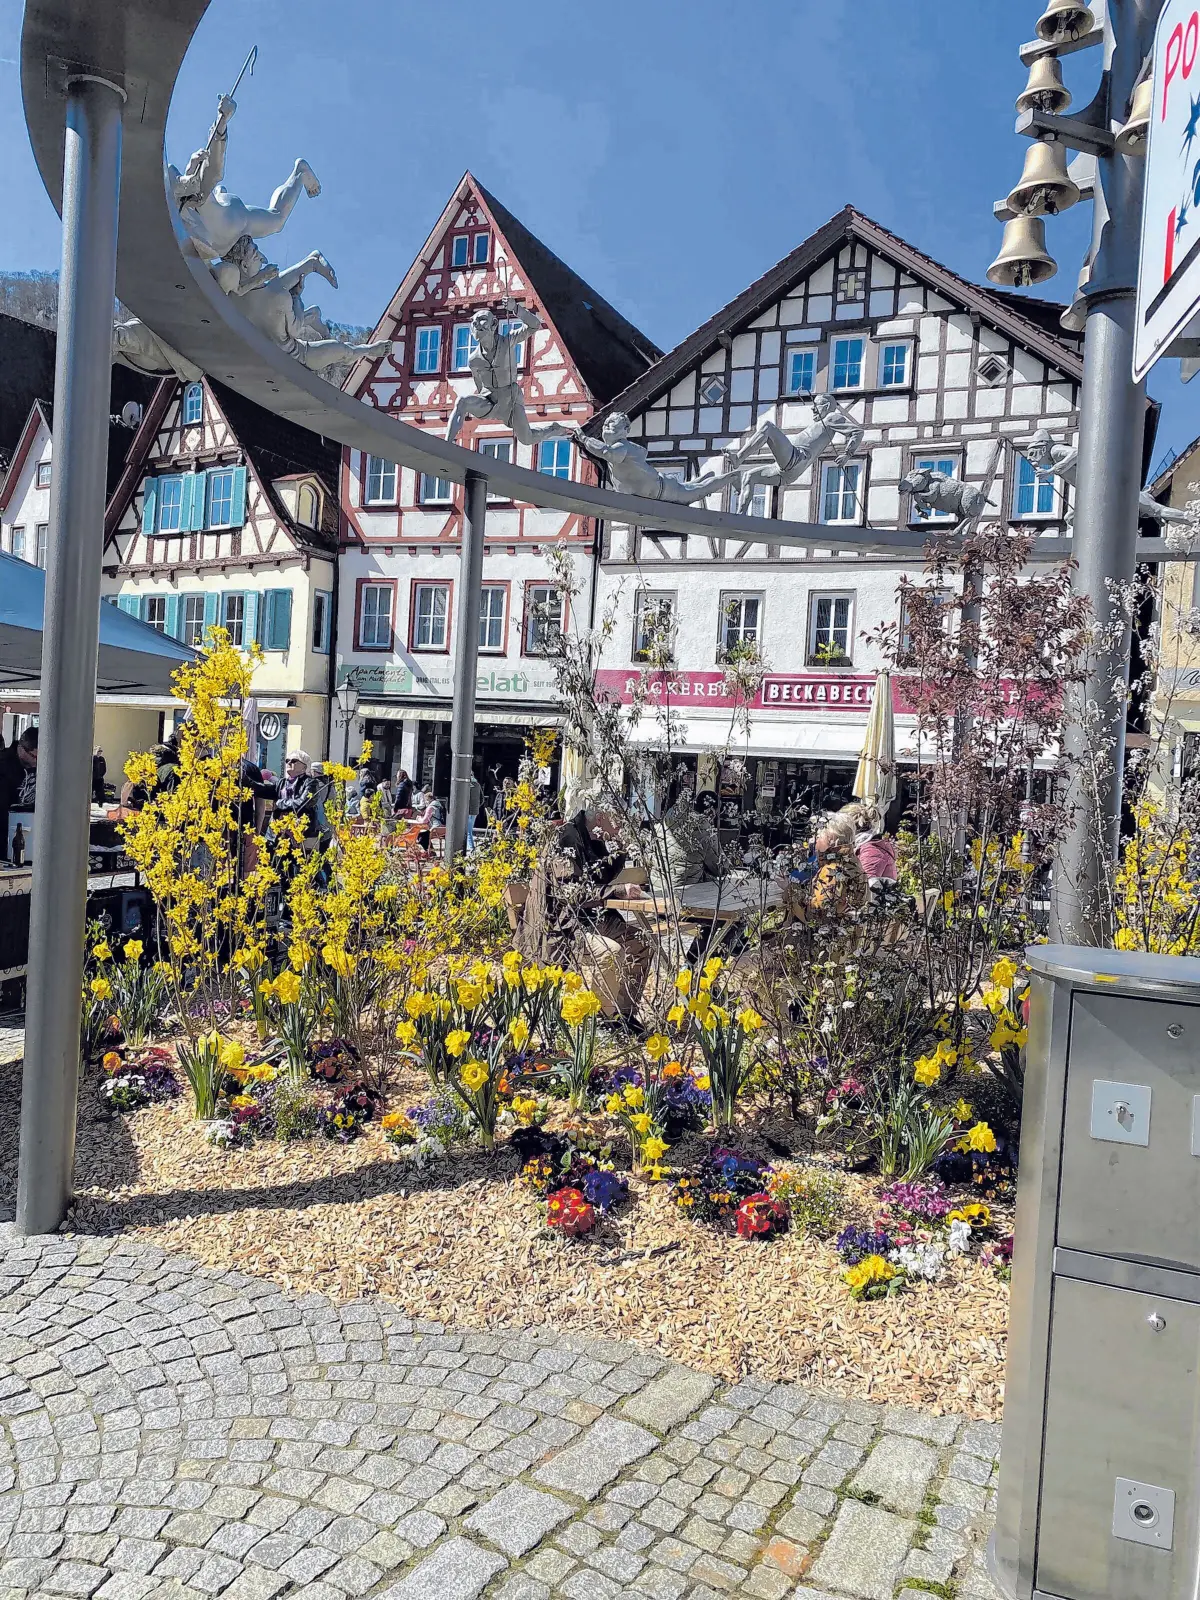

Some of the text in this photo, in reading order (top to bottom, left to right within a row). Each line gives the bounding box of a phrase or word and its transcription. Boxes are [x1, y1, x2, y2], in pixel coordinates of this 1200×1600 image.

[351, 665, 407, 678] Apartments
[475, 671, 530, 693] elati
[769, 684, 875, 701] BECKABECK
[335, 719, 344, 728] 12
